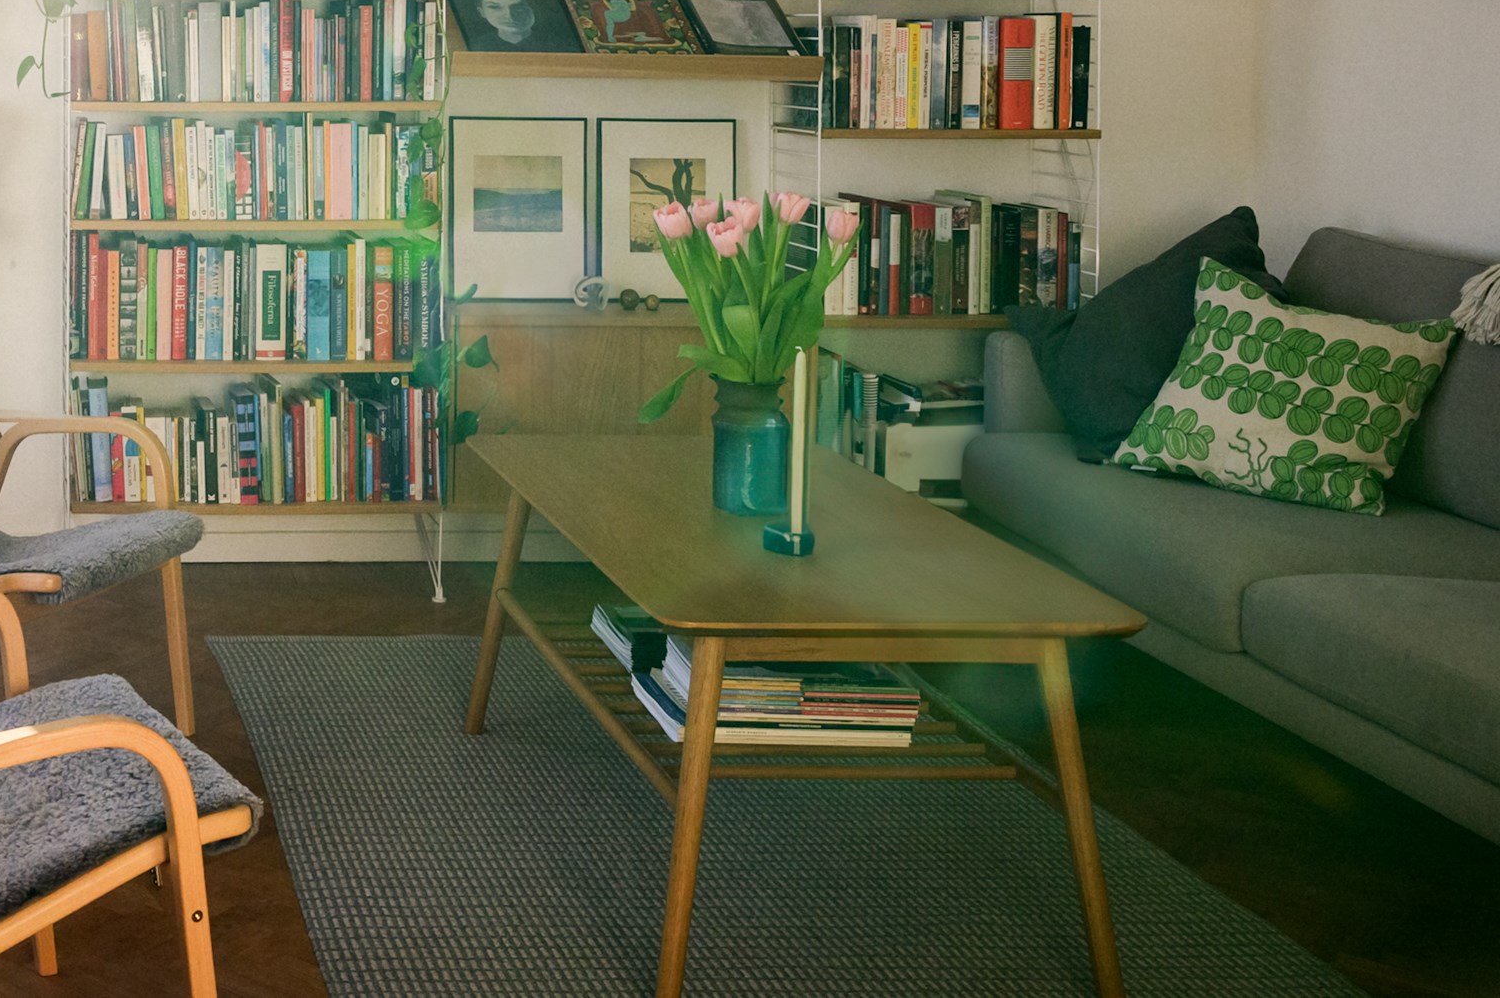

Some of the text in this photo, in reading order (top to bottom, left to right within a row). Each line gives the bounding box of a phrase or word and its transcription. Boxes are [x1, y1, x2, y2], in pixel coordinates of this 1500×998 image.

[883, 22, 892, 66] JERUSALEM
[1038, 44, 1046, 81] GOLDEN
[1046, 26, 1056, 113] WILLIAM DALRYMPLE
[1037, 82, 1046, 111] ROAD
[90, 275, 98, 301] Kalman
[175, 249, 186, 311] BLACK HOLE
[267, 274, 278, 325] Filosoferna
[403, 296, 409, 306] ON
[375, 289, 389, 337] YOGA
[421, 304, 429, 348] SYMBOLS
